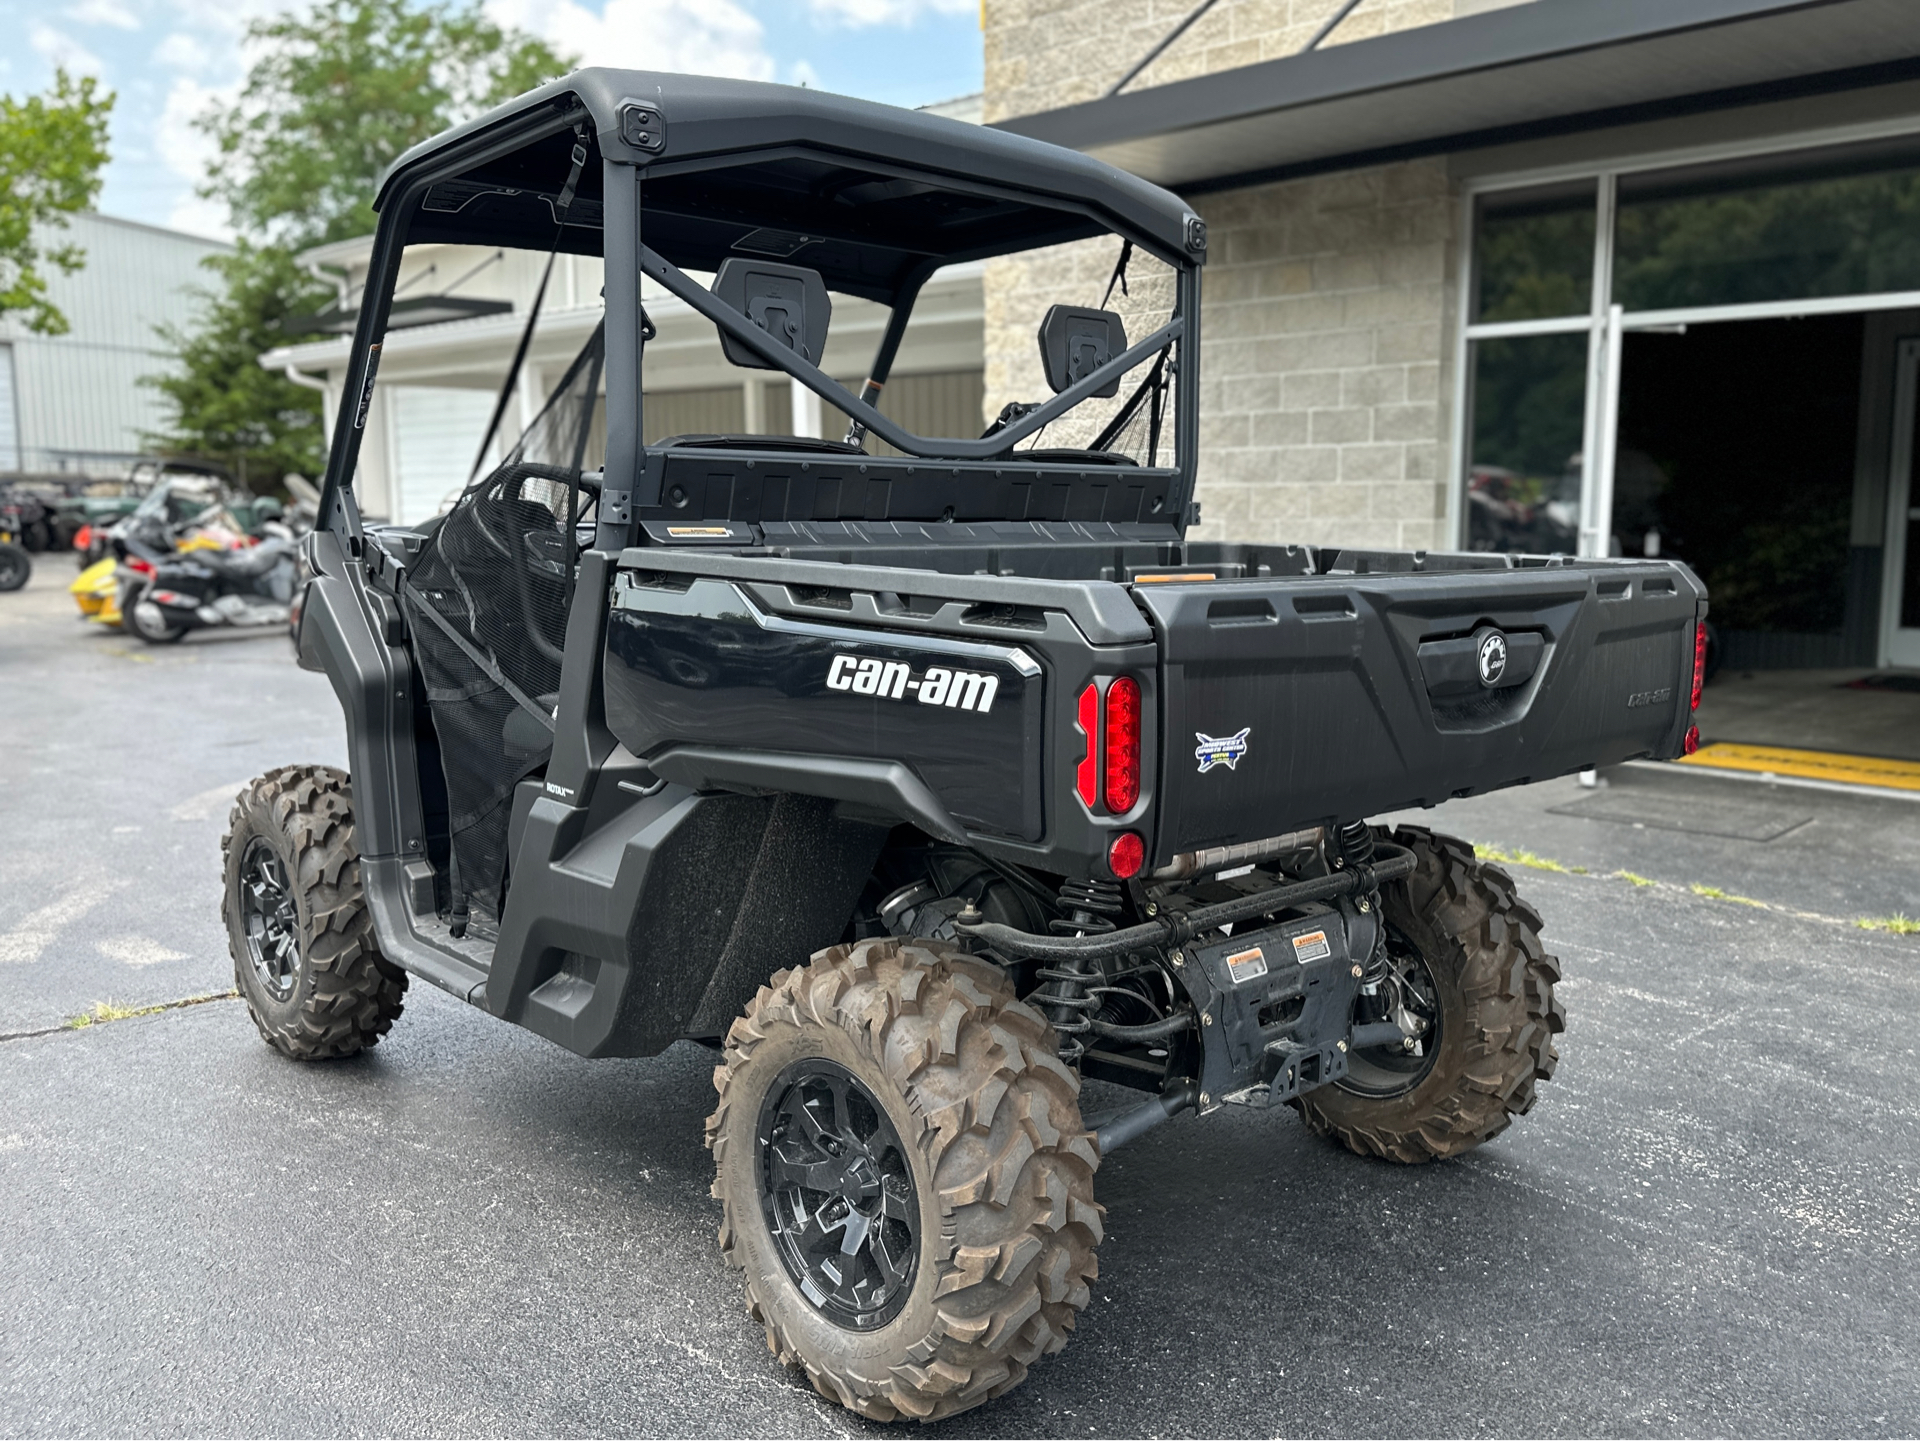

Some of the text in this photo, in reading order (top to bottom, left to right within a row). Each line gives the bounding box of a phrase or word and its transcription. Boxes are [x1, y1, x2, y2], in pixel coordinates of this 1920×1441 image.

[826, 655, 999, 713] can-am
[1203, 739, 1241, 748] MIDWEST
[547, 782, 566, 797] ROTAX
